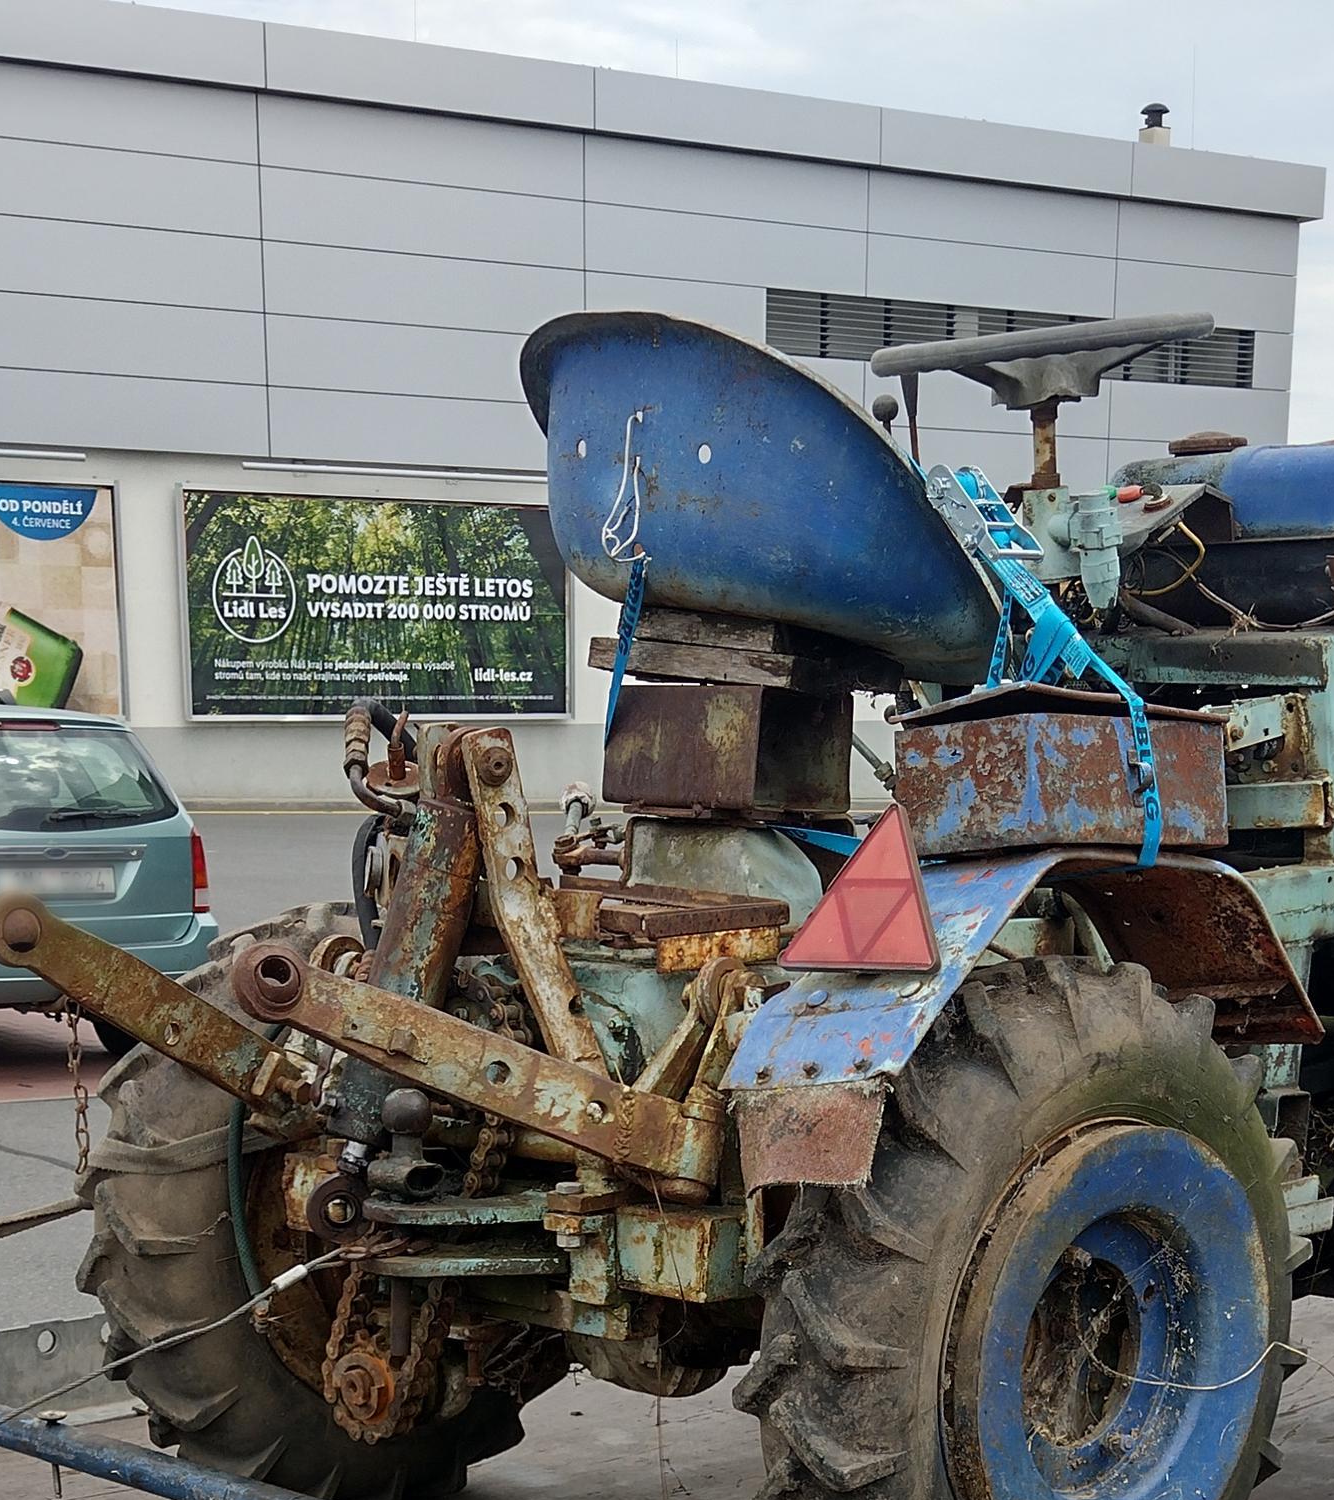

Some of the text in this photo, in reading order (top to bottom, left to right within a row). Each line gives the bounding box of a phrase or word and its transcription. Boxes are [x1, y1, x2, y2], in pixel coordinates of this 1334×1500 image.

[21, 500, 83, 515] PONDĚLÍ
[11, 515, 71, 529] 4. ČERVENCE
[307, 572, 533, 598] POMOZTE JEŠTĚ LETOS
[223, 600, 287, 619] Lidl Les
[307, 601, 531, 621] VYSADIT 200 000 STROMŮ
[214, 658, 254, 670] Nákupem
[255, 659, 289, 670] výrobků
[308, 660, 323, 671] kraj
[324, 661, 334, 669] se
[334, 660, 379, 671] jednoduše
[412, 662, 423, 670] na
[214, 670, 244, 680] stromů
[245, 671, 264, 681] tam,
[282, 672, 292, 680] to
[474, 667, 533, 682] lidl-les.cz
